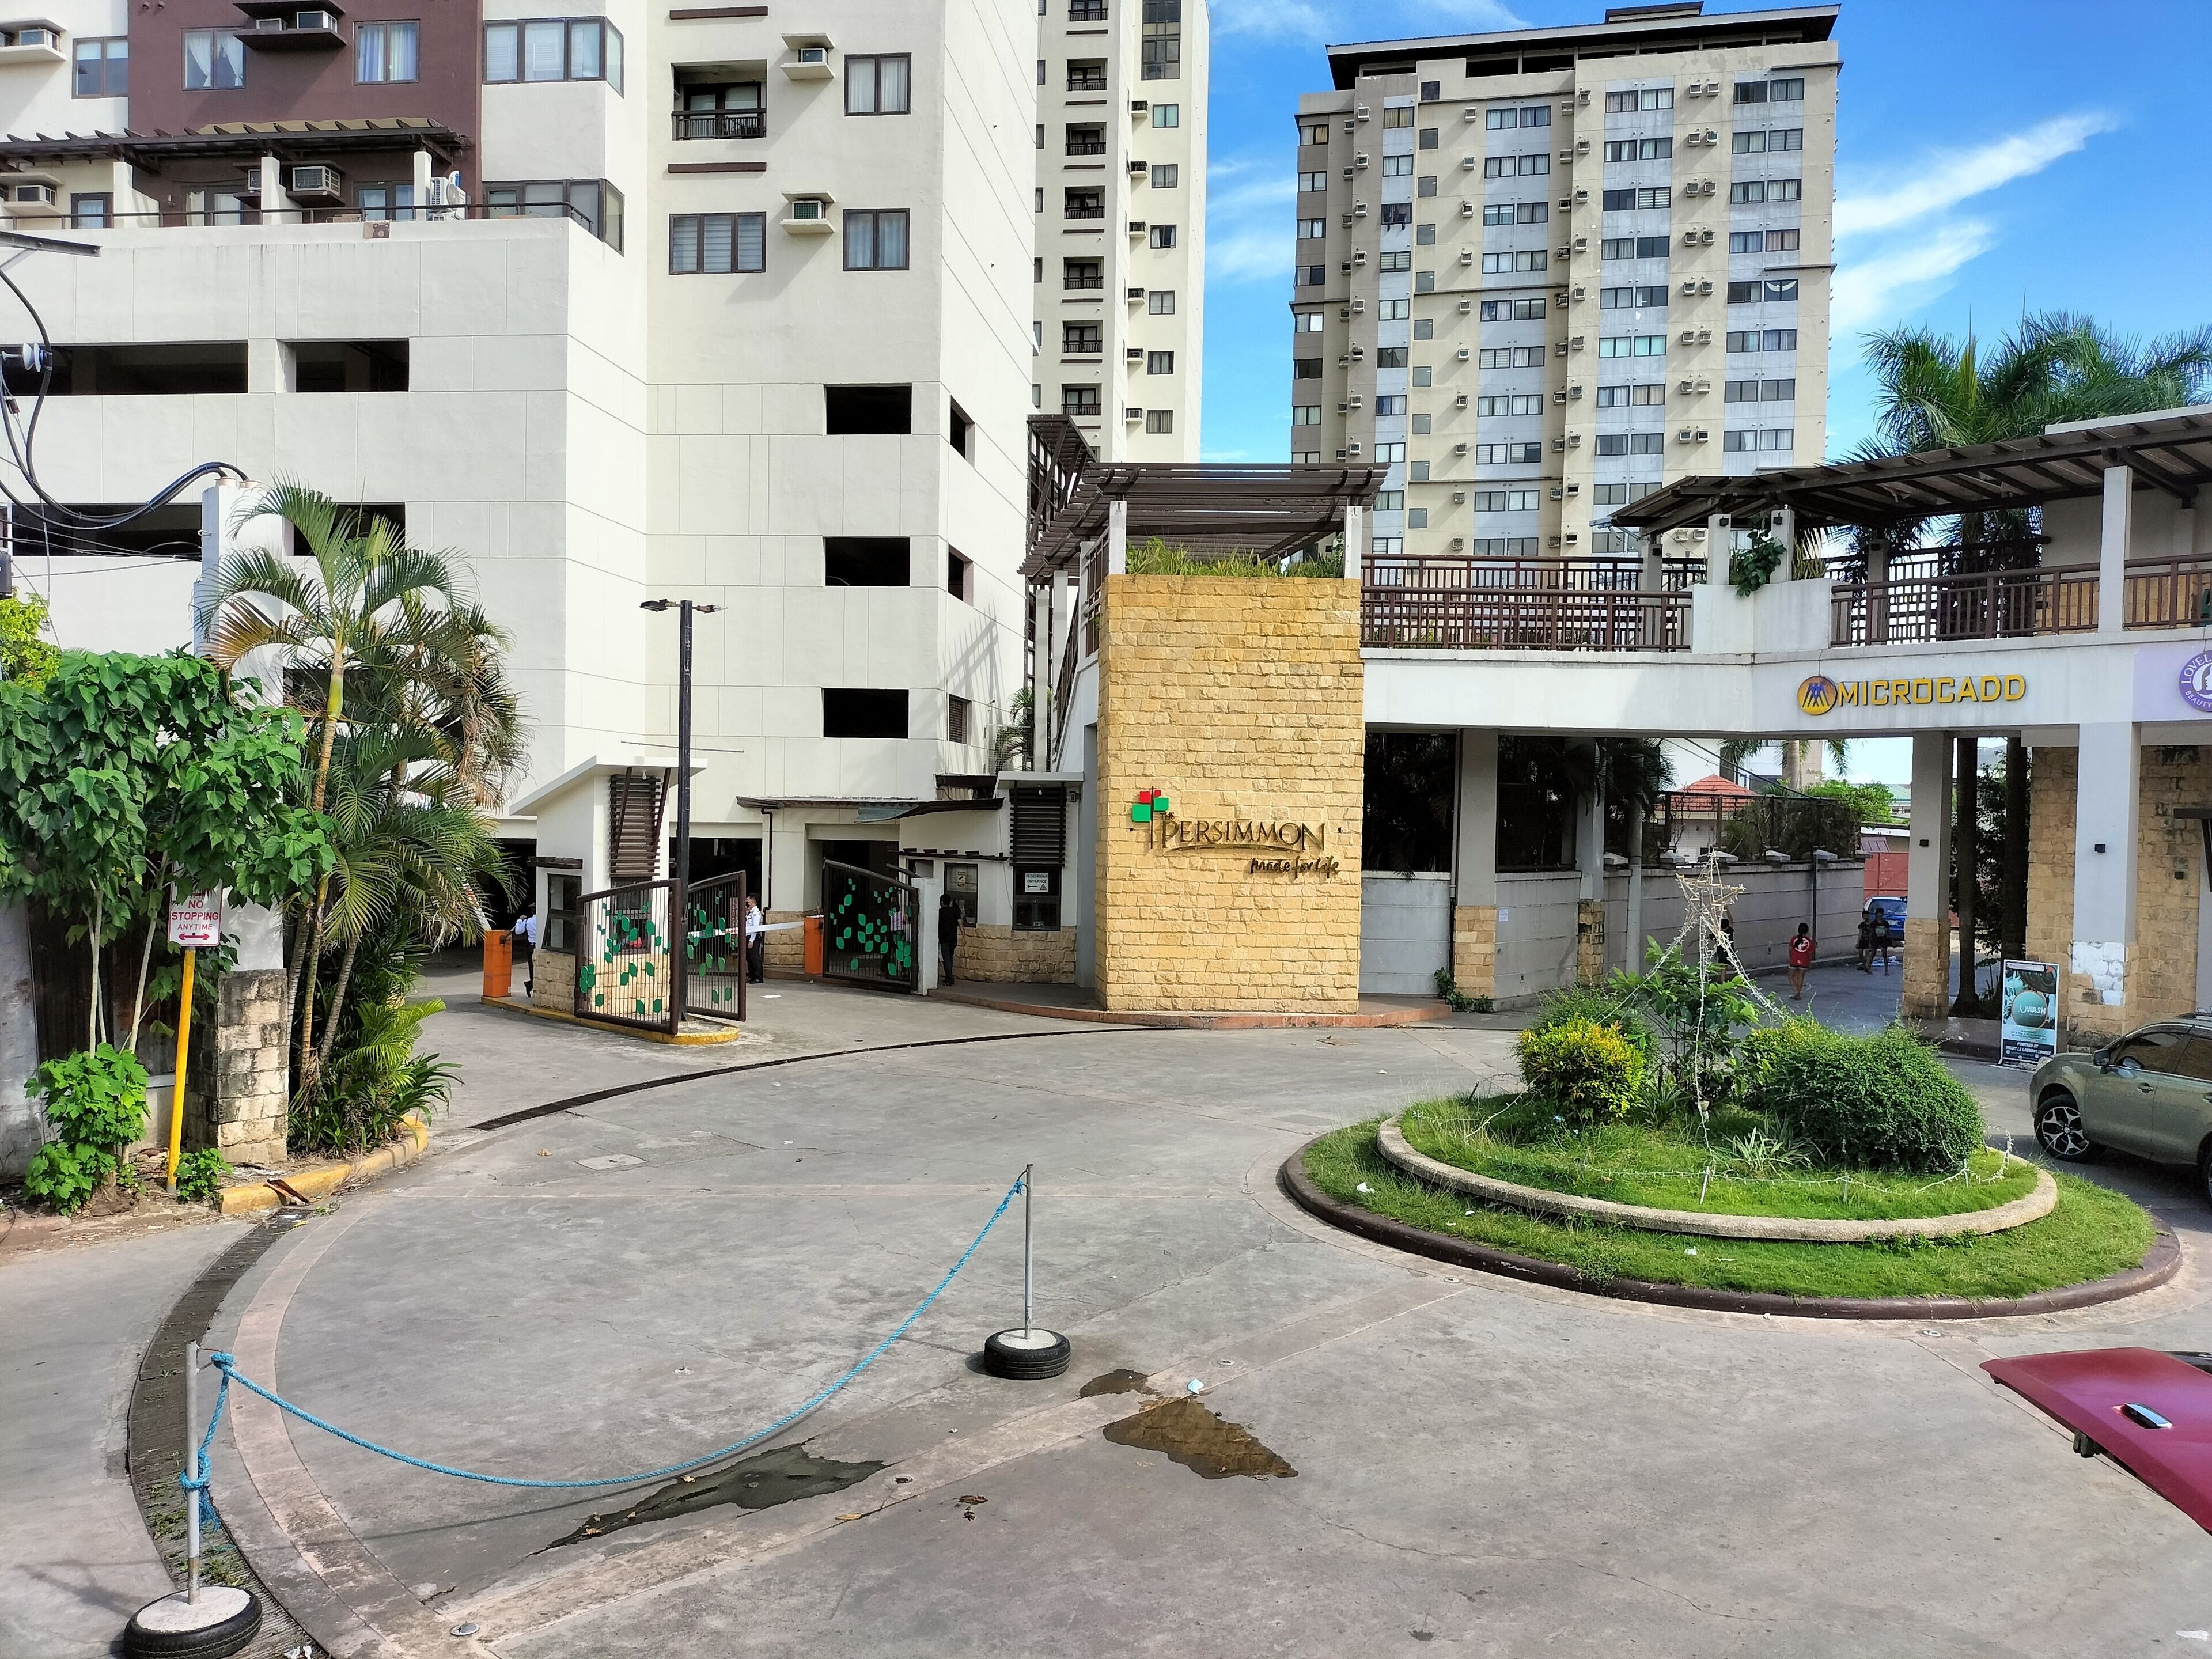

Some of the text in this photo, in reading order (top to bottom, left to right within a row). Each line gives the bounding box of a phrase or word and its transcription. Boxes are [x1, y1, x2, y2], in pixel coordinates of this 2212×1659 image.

[1838, 673, 2027, 707] MICROCADD
[2185, 690, 2211, 708] BEAUTY
[1161, 820, 1325, 851] PERSIMMON
[188, 900, 204, 908] NO
[172, 912, 219, 921] STOPPING
